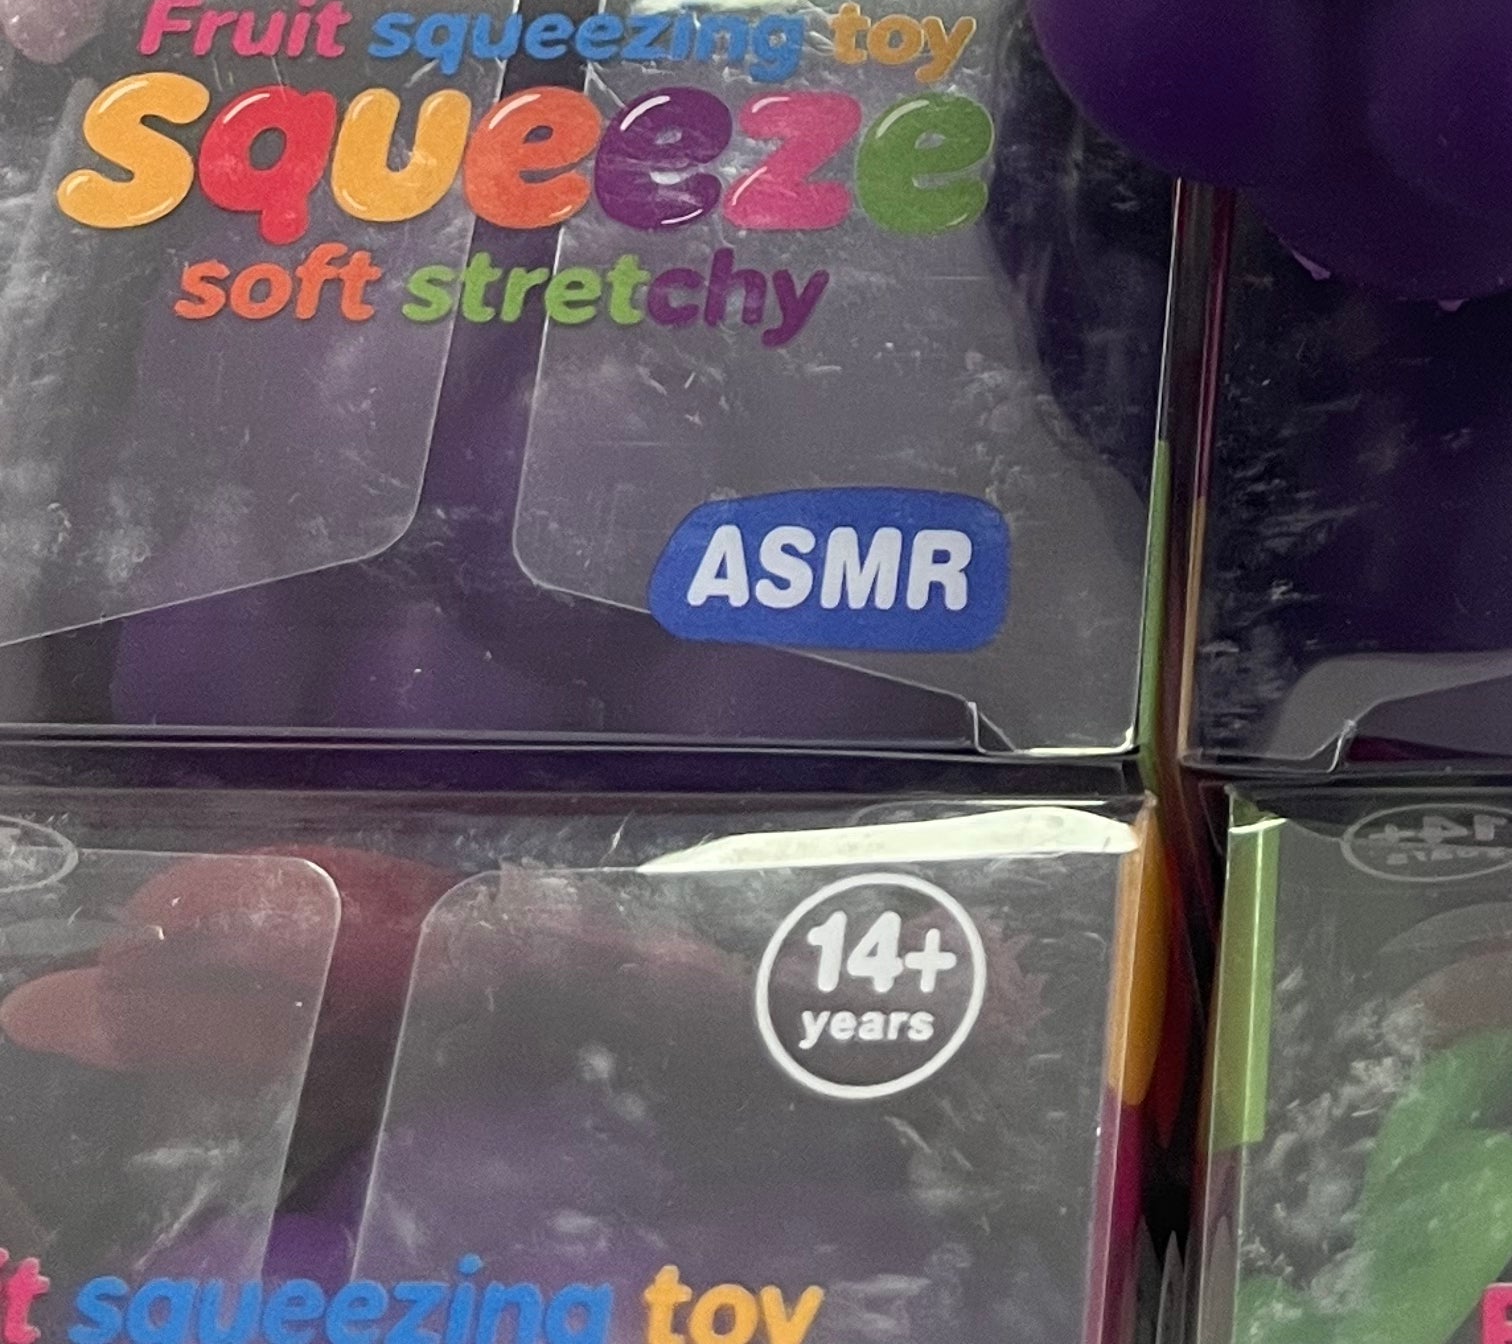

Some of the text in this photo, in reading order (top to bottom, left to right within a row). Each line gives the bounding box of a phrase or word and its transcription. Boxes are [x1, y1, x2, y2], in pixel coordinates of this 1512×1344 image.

[368, 3, 806, 83] squeezing
[830, 2, 976, 83] toy
[57, 71, 995, 244] squeeze
[174, 243, 831, 348] soft stretchy
[687, 524, 973, 611] ASMR
[807, 910, 957, 993] 14+
[798, 1010, 935, 1050] years
